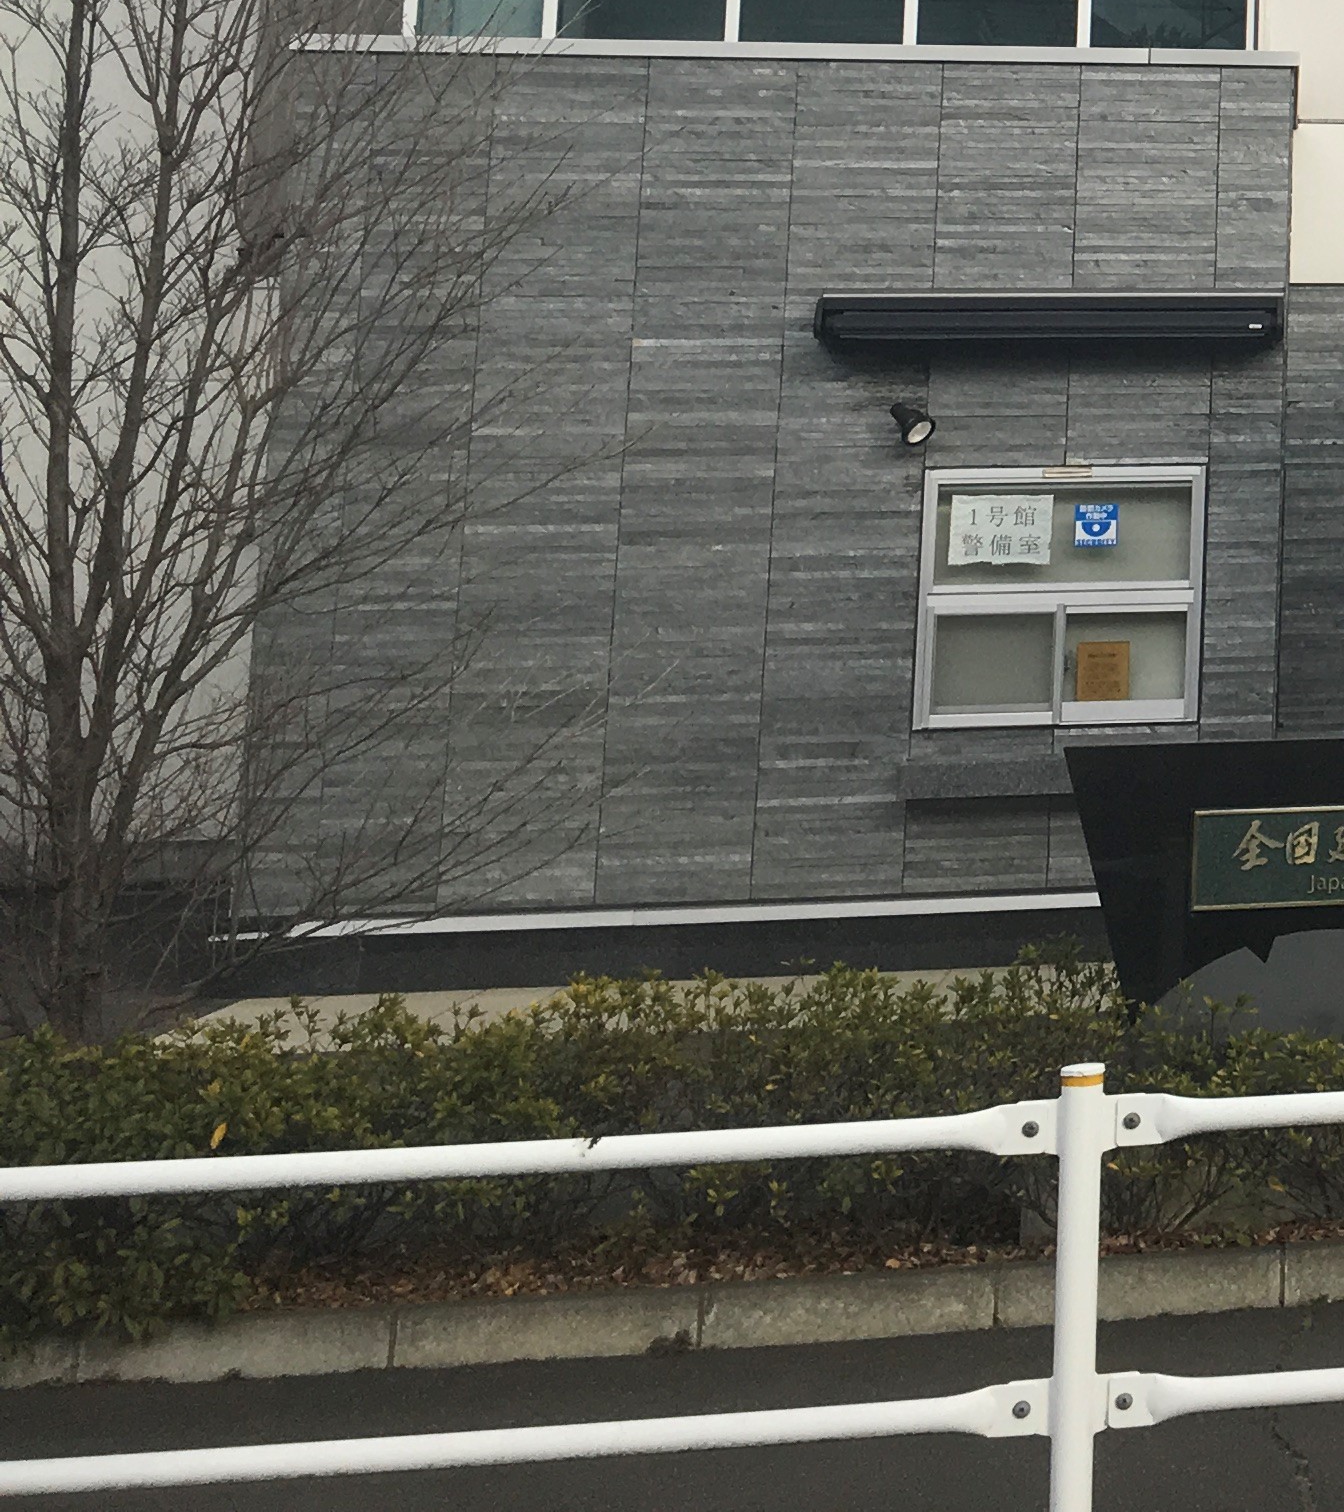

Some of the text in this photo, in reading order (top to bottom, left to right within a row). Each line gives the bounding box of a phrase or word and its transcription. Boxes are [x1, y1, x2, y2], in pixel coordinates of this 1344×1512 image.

[970, 506, 1037, 527] 1号館
[961, 534, 1041, 556] 警備室
